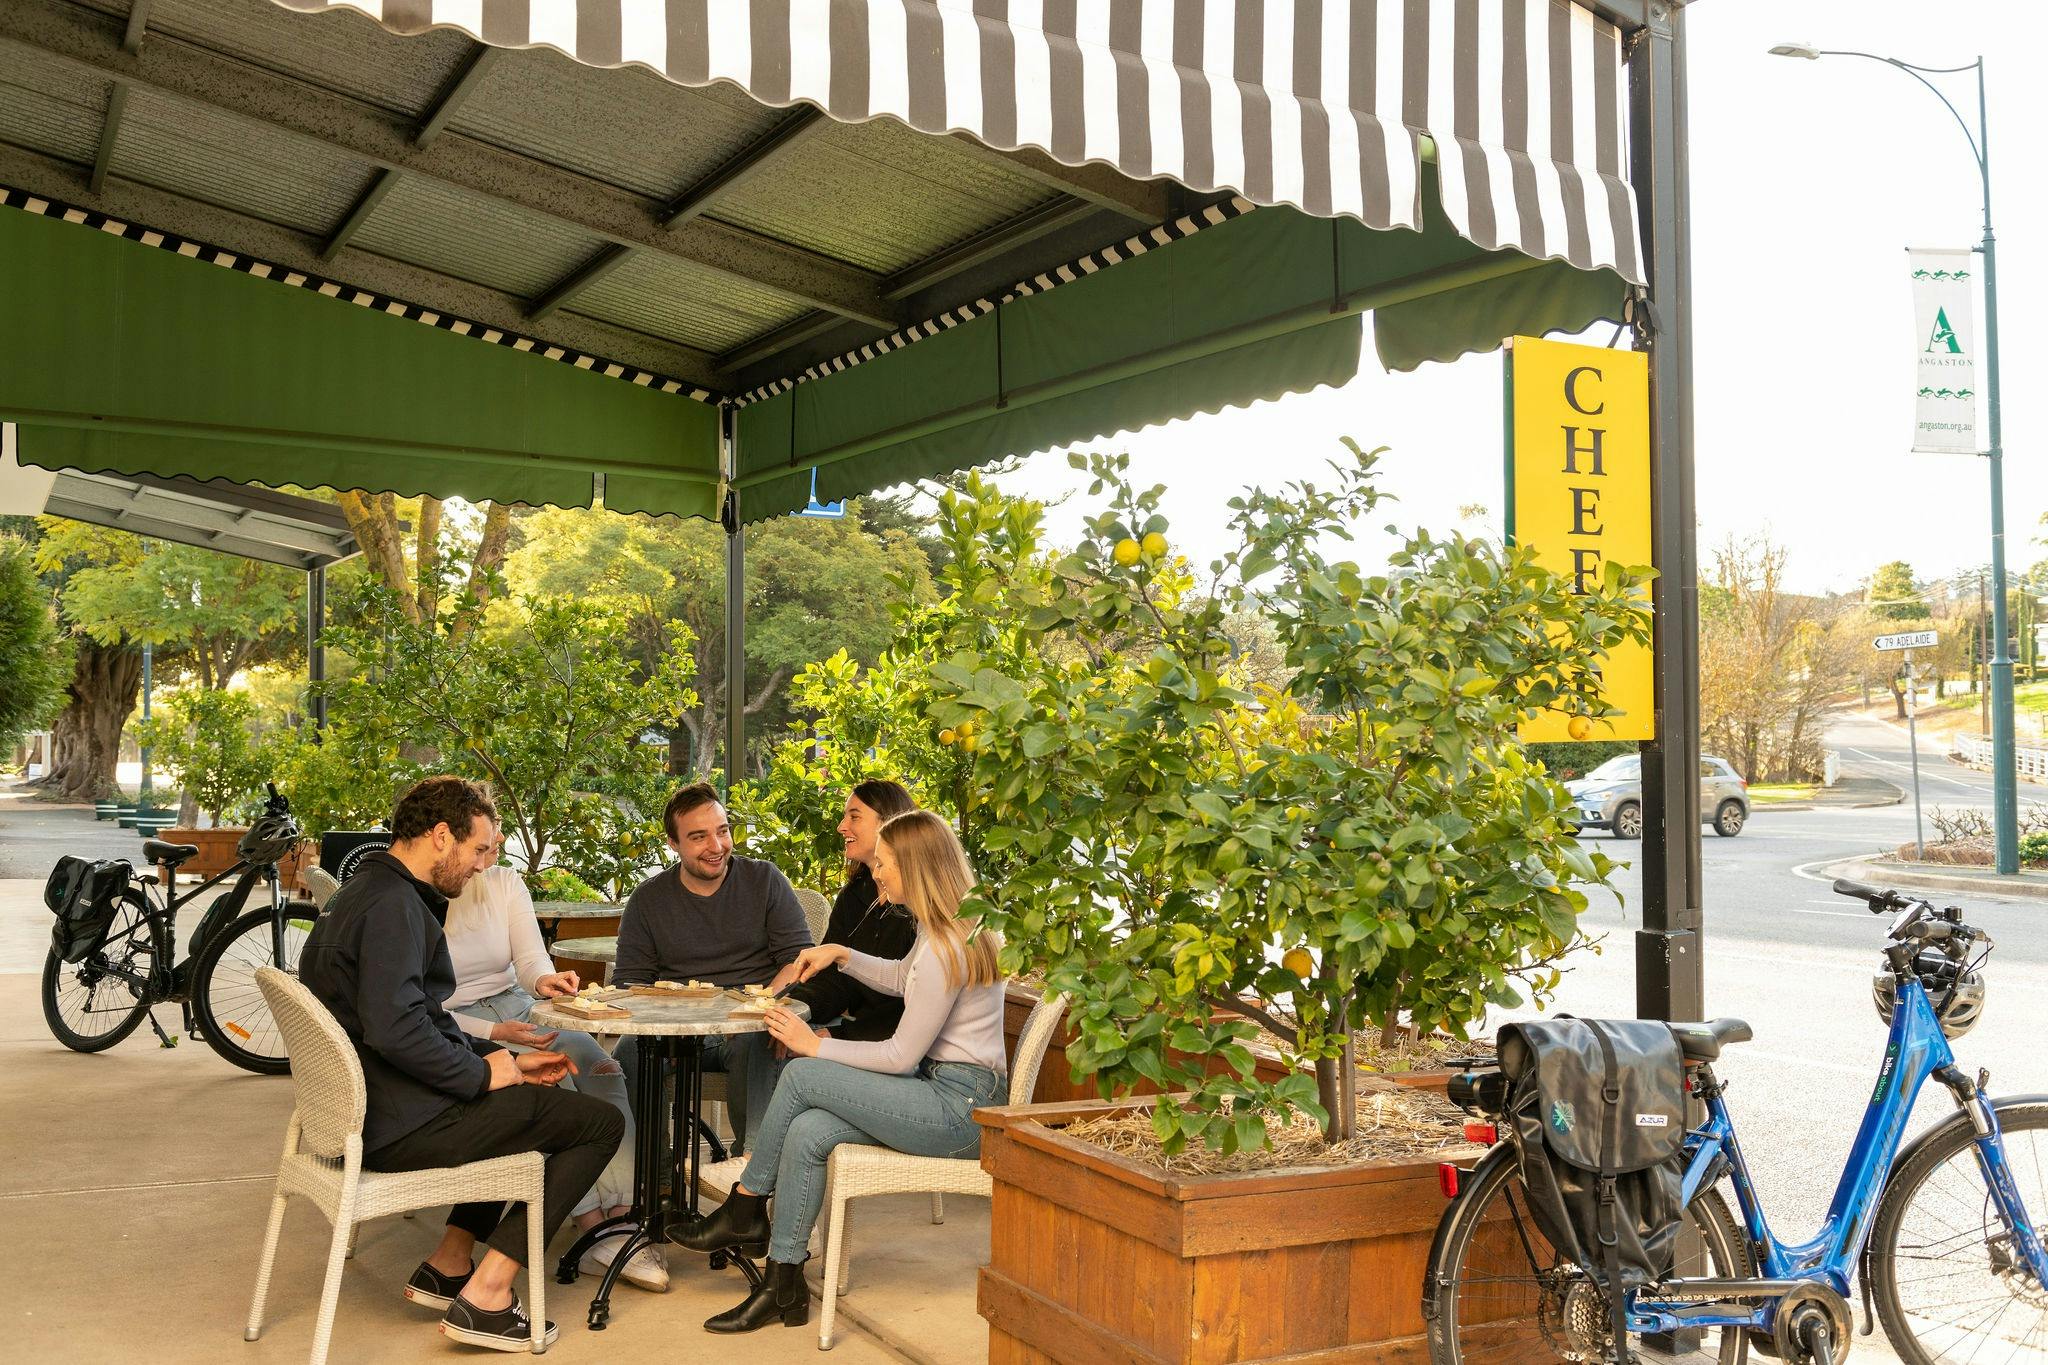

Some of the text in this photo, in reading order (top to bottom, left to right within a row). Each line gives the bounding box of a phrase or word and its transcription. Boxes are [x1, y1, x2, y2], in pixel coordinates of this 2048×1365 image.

[1918, 358, 1974, 367] ANGASTON
[1918, 420, 1973, 433] angaston.org.au
[1561, 366, 1607, 718] CHEEE
[1884, 633, 1931, 648] 79 ADELAIDE
[1639, 1116, 1665, 1124] AZUR
